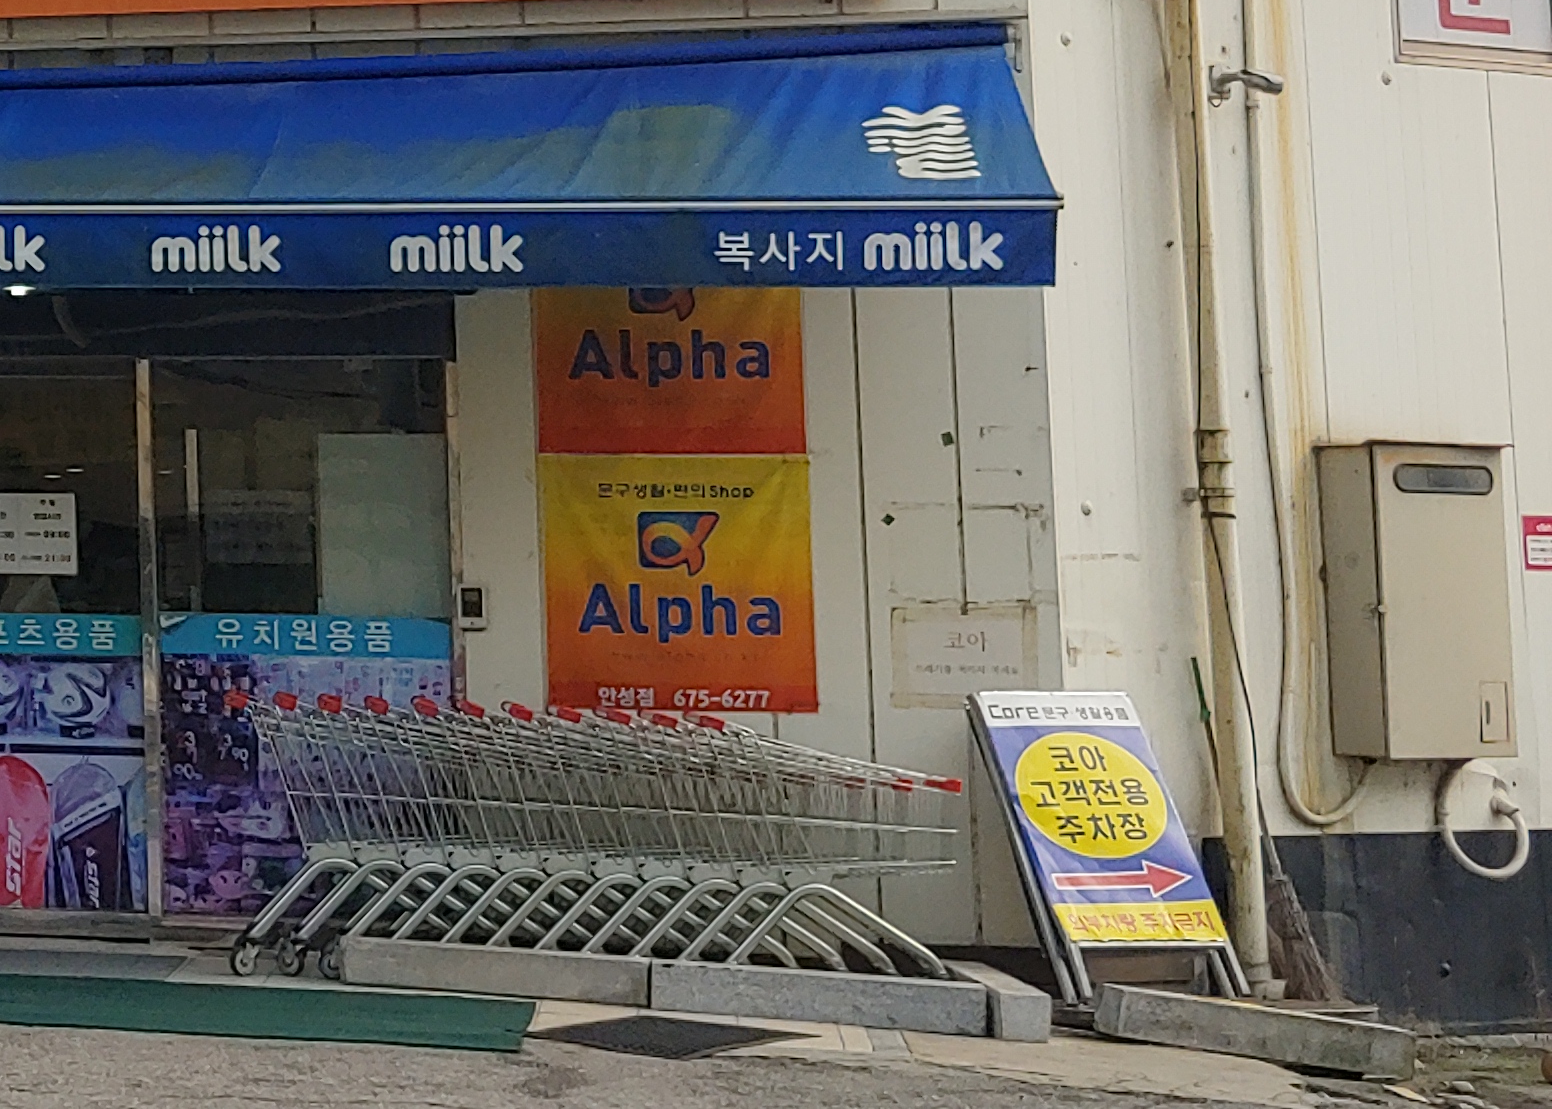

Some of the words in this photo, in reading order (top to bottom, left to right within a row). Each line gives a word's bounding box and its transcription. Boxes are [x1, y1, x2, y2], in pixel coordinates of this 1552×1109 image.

[151, 225, 281, 272] miilk
[390, 225, 524, 273] miilk
[714, 230, 844, 271] 복사지
[864, 221, 1004, 271] miilk
[569, 328, 771, 387] Alpha
[579, 583, 781, 643] Alpha
[215, 618, 394, 653] 유치원용품
[944, 631, 986, 652] 코아
[598, 687, 654, 707] 안성점
[674, 689, 770, 709] 675-6277
[1048, 745, 1107, 772] 코아
[1030, 778, 1148, 808] 고객전용
[1055, 813, 1148, 844] 주차장
